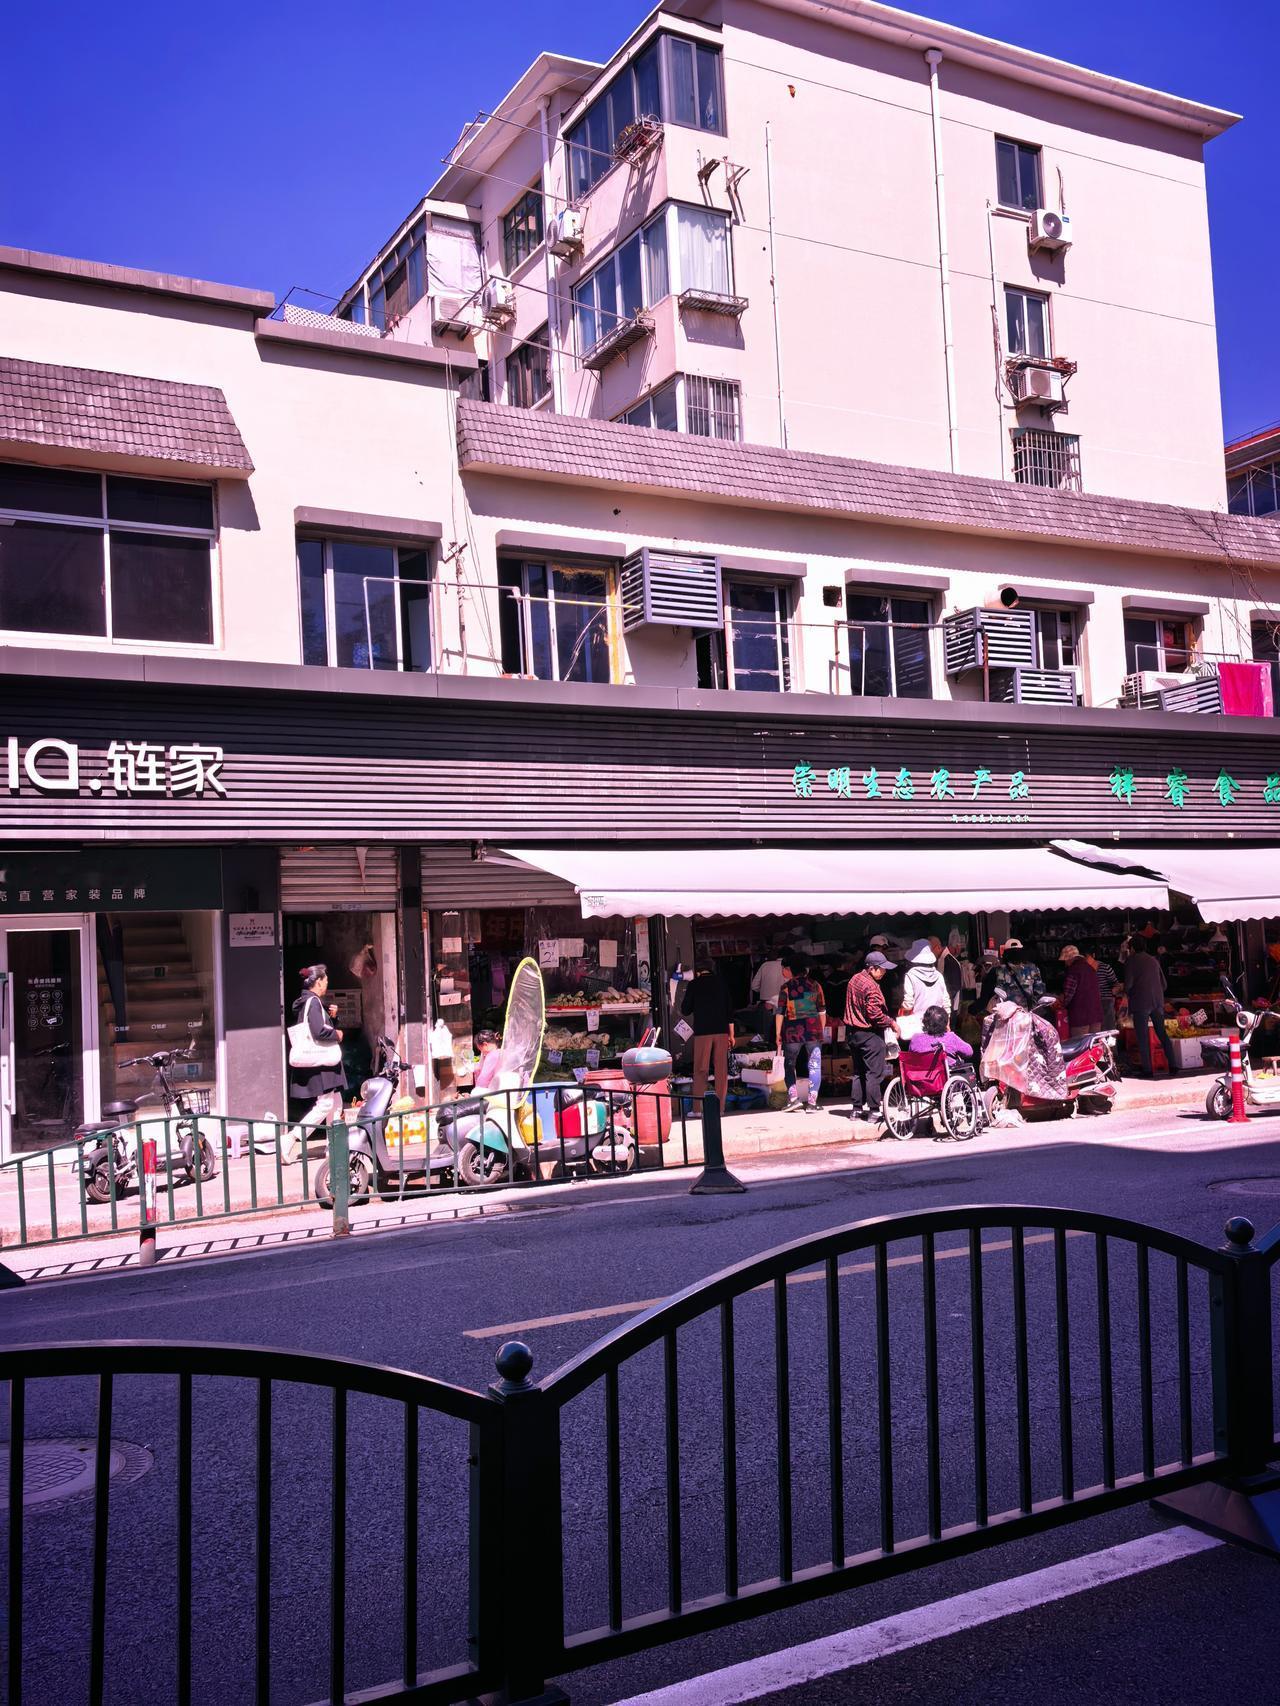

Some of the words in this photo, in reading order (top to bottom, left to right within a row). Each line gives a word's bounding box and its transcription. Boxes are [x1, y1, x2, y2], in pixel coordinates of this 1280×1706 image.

[107, 740, 227, 793] 链家
[792, 760, 1029, 800] 崇明生态农产品
